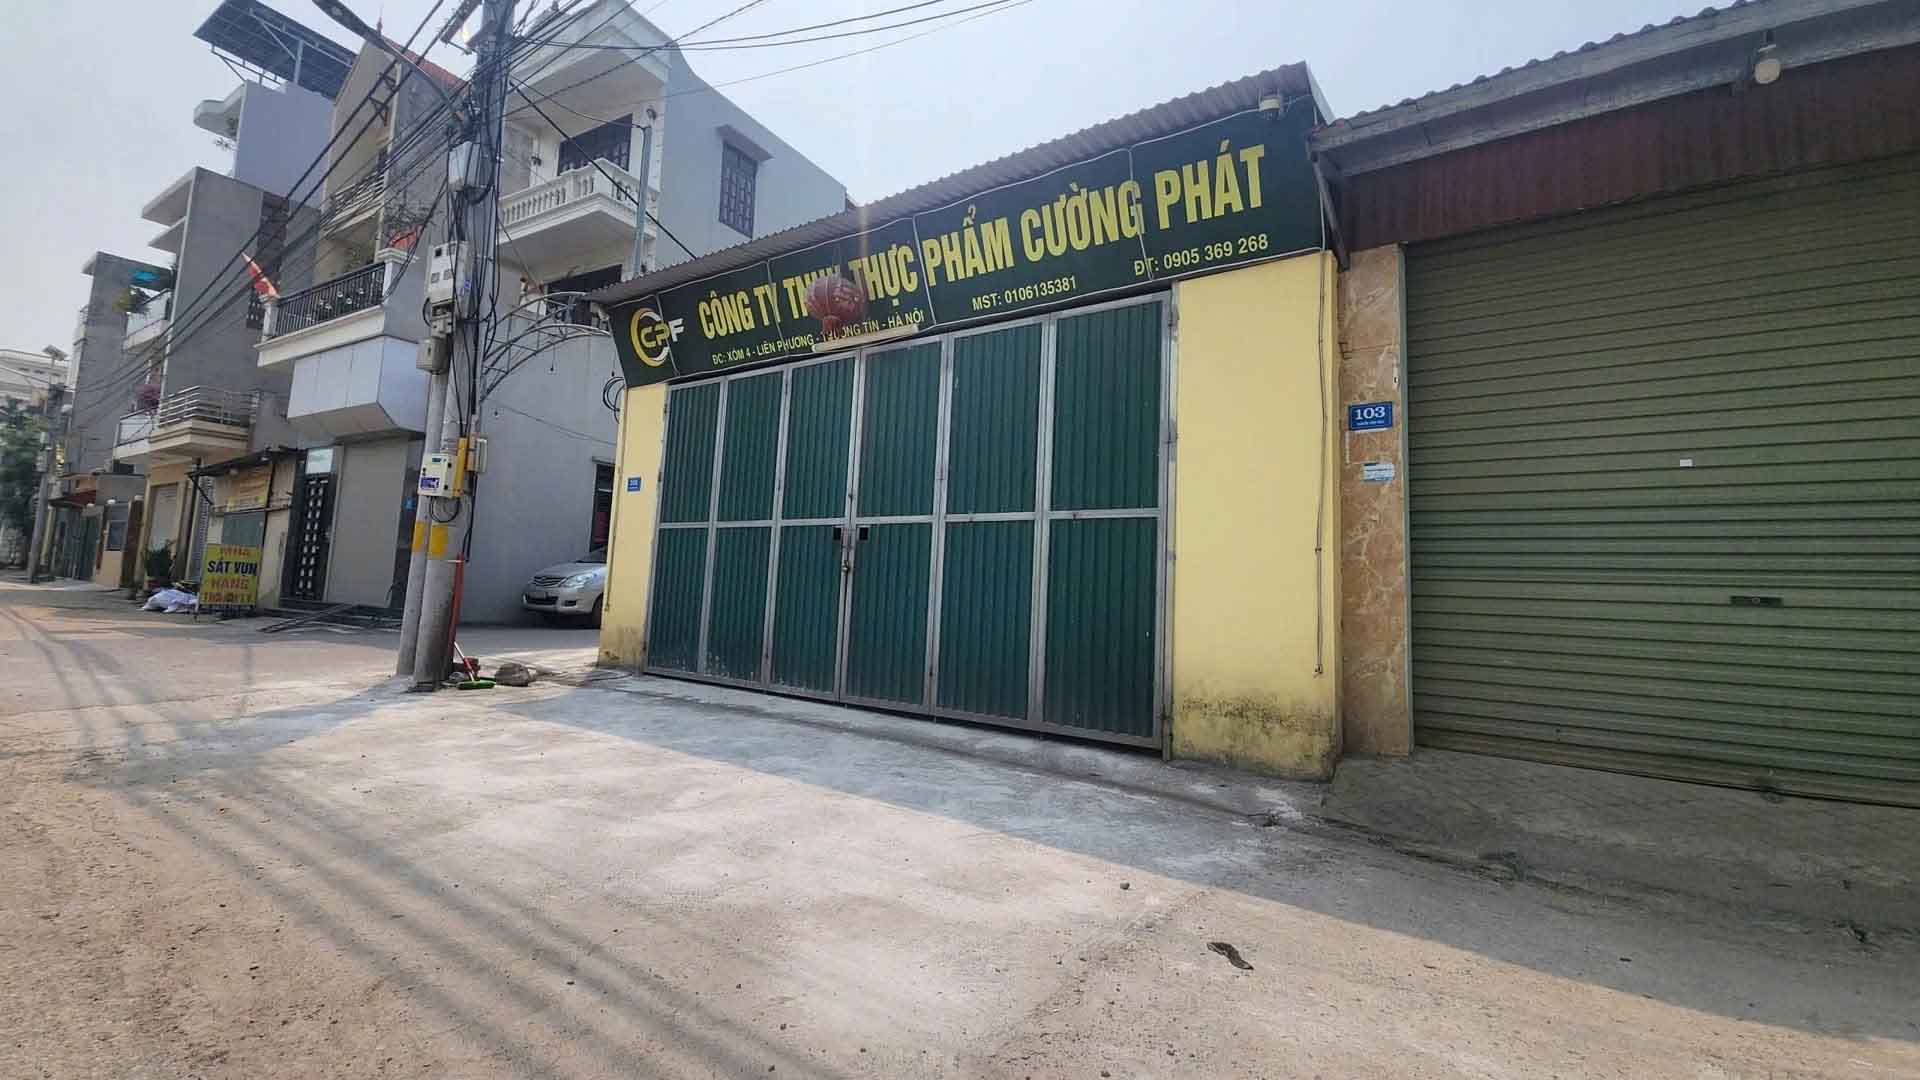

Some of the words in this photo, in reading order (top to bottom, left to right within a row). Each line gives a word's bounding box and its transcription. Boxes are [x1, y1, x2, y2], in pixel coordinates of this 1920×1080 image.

[699, 290, 755, 339] CÔNG
[753, 283, 781, 326] TY
[848, 244, 918, 306] THỰC
[922, 205, 1015, 287] PHẨM
[1021, 182, 1145, 262] CƯỜNG
[1154, 139, 1265, 230] PHÁT
[1134, 257, 1159, 276] ĐT:
[1163, 248, 1200, 270] 0905
[1204, 241, 1233, 261] 369
[1238, 233, 1269, 254] 268
[972, 293, 1002, 311] MST:
[1005, 275, 1076, 304] 0106135381
[1355, 407, 1386, 420] 103
